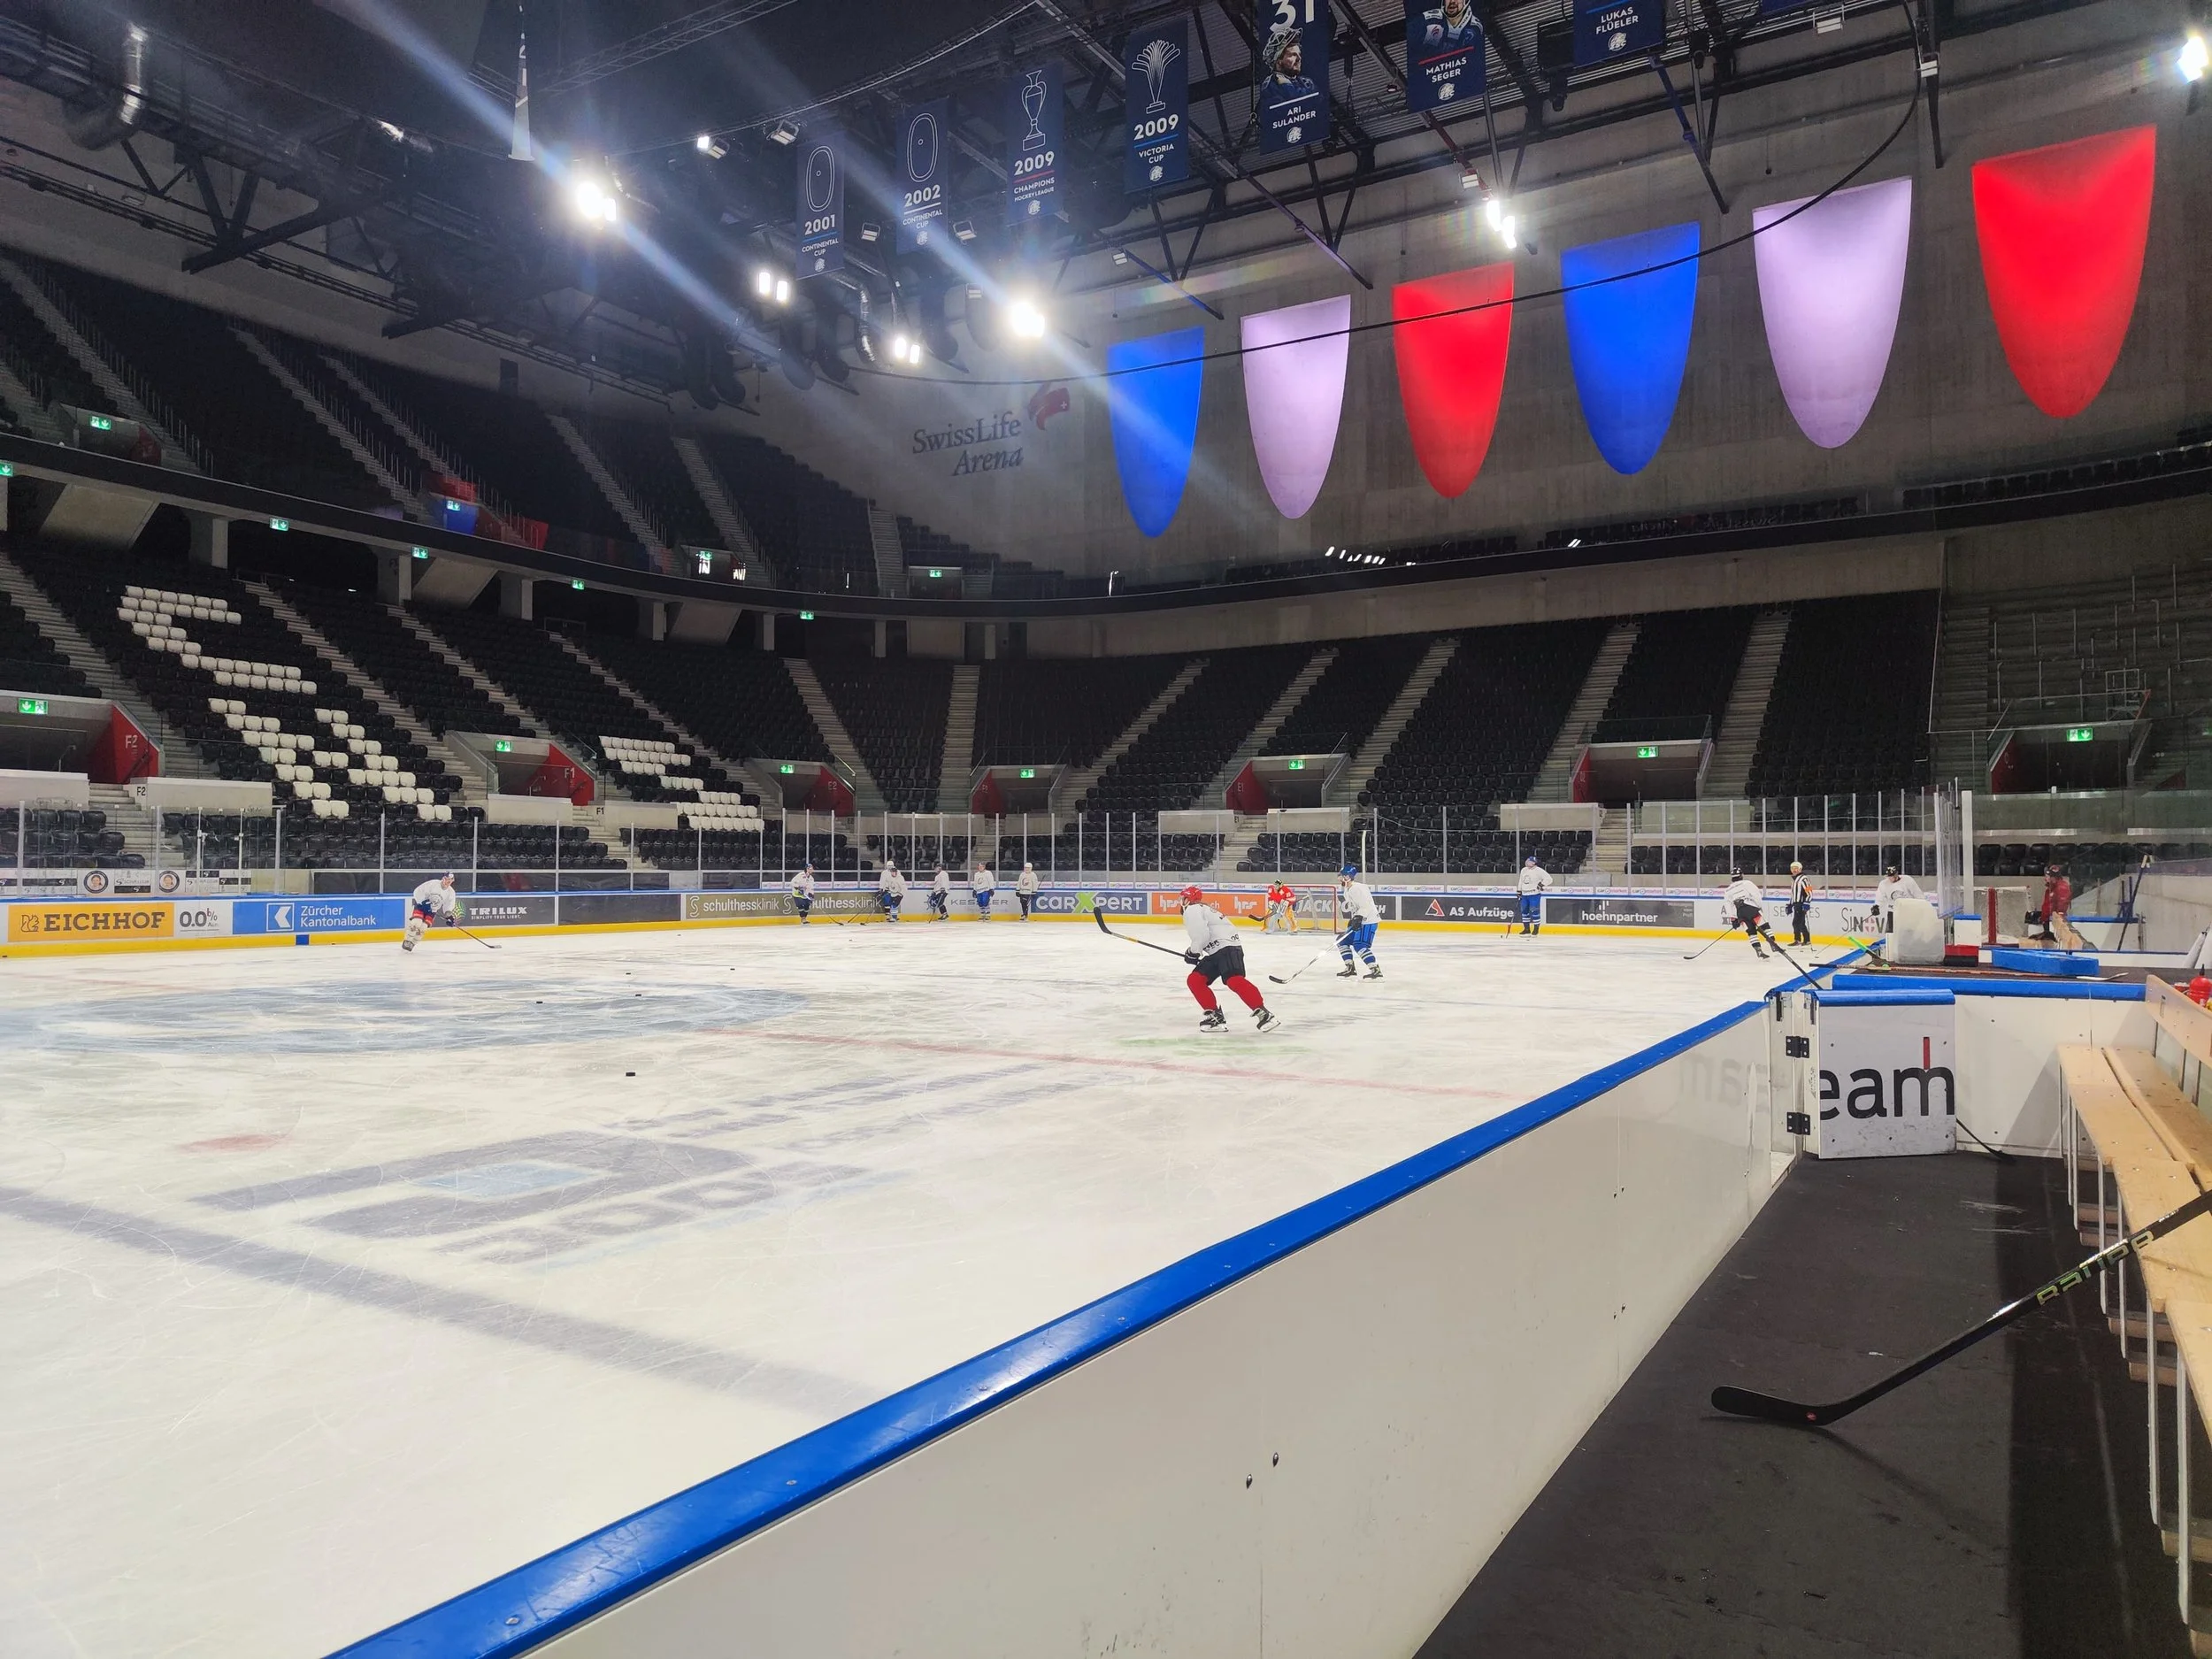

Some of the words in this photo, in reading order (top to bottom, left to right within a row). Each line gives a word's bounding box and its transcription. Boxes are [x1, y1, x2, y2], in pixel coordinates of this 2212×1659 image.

[1601, 7, 1634, 24] LUKAS
[1596, 15, 1639, 35] FLÜELER
[1426, 58, 1467, 75] MATHIAS
[1432, 69, 1461, 83] SEGER
[1287, 106, 1302, 116] ARI
[1133, 114, 1179, 141] 2009
[1272, 111, 1317, 129] SULANDER
[1139, 143, 1174, 158] VICTORIA
[1014, 151, 1055, 176] 2009
[1148, 154, 1164, 164] CUP
[1013, 177, 1055, 195] CHAMPIONS
[904, 184, 941, 208] 2002
[1014, 191, 1035, 203] HOCKEY
[1034, 187, 1055, 198] LEAGUE
[804, 214, 835, 235] 2001
[902, 209, 942, 226] CONTINENTAL
[916, 220, 929, 229] CUP
[802, 238, 839, 253] CONTINENTAL
[952, 446, 1025, 477] Arena
[125, 734, 138, 749] F2
[565, 767, 575, 779] F1
[136, 787, 146, 796] F2
[301, 904, 343, 917] Zürcher
[469, 906, 527, 916] TRILUX
[703, 897, 780, 912] schulthessklinik
[1449, 907, 1464, 916] AS
[1469, 905, 1514, 918] Aufzüge
[43, 911, 165, 932] EICHHOF
[300, 914, 377, 928] Kantonalbank
[1581, 910, 1658, 923] hoehnpartner
